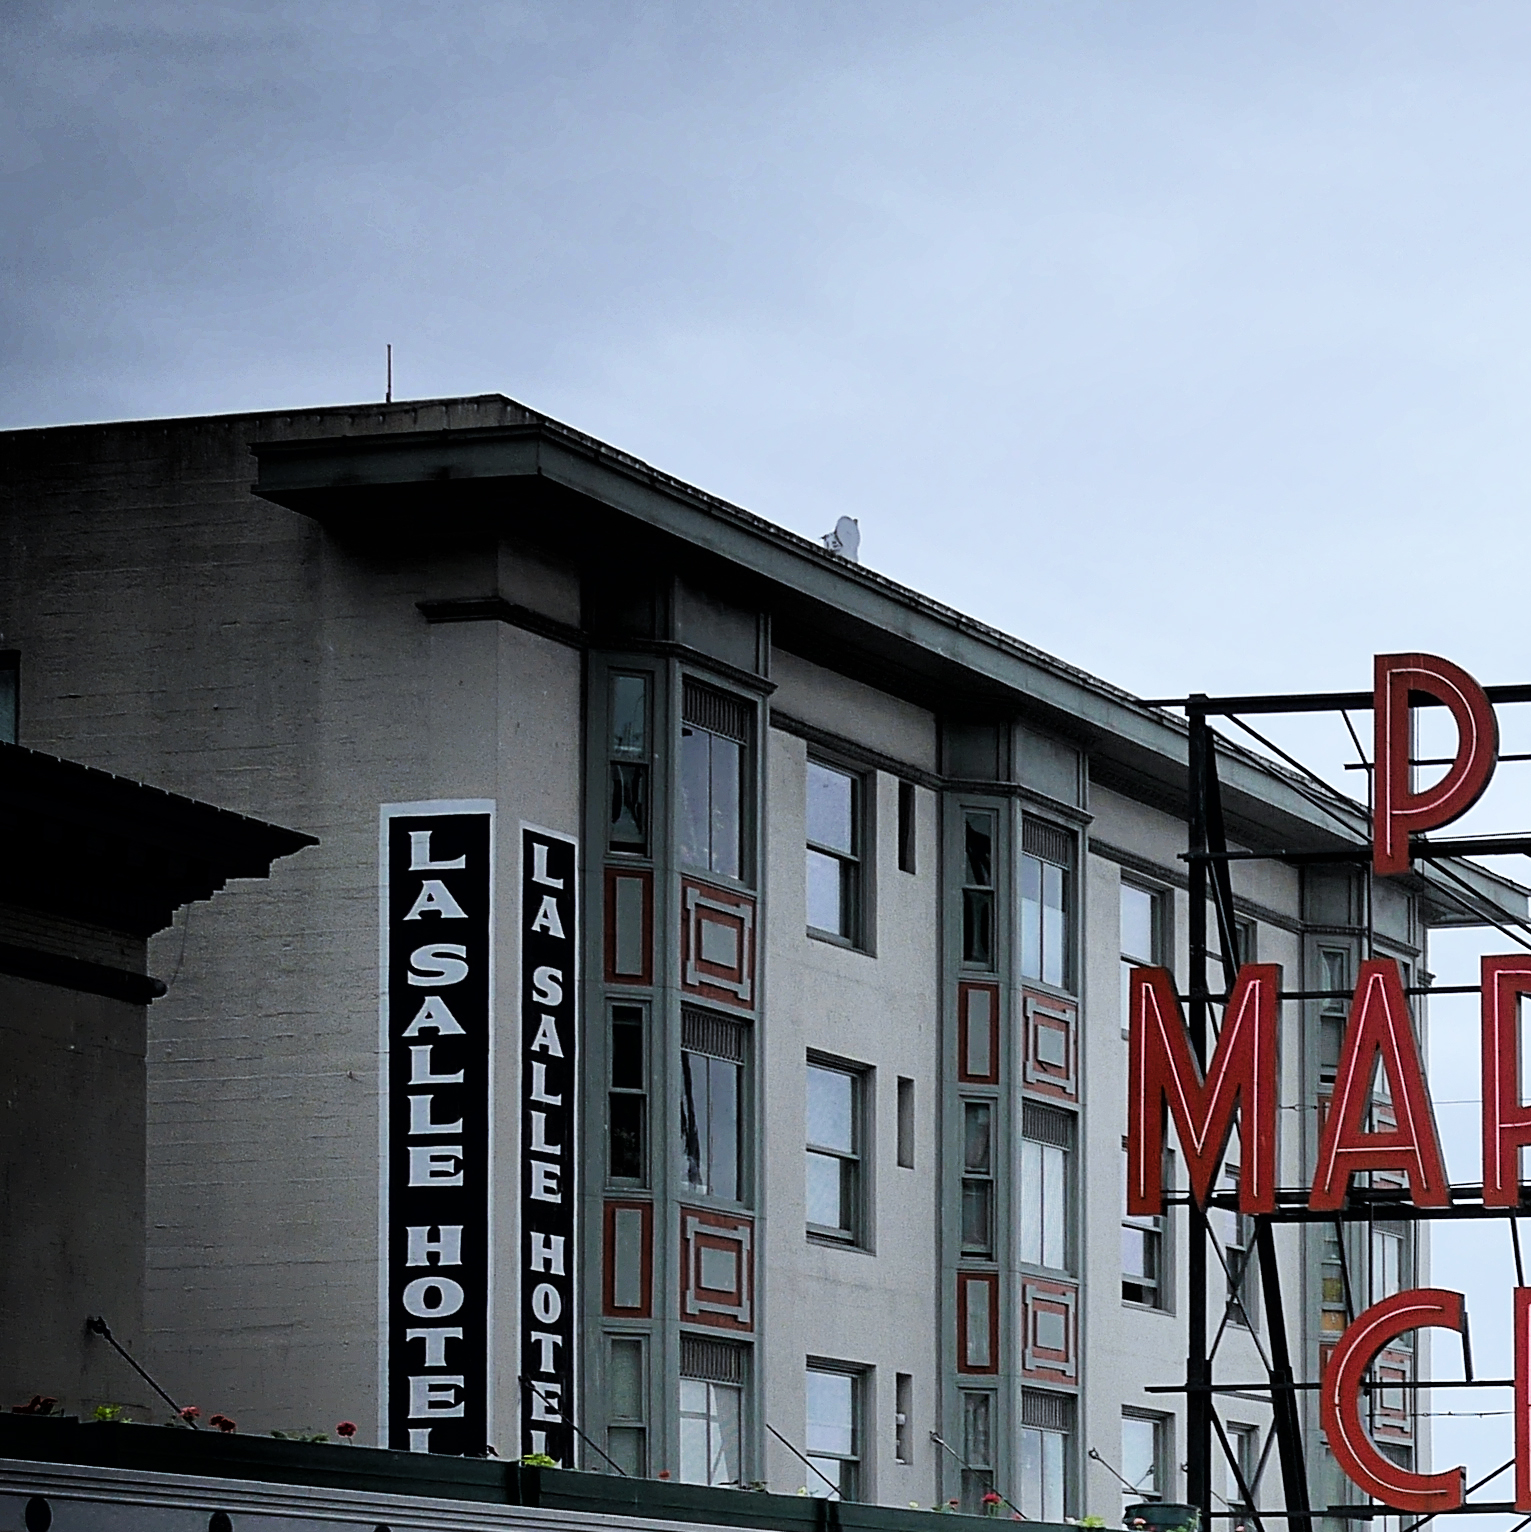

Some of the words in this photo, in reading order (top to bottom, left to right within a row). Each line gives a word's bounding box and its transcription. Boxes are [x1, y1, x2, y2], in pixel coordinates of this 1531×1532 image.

[402, 830, 469, 920] LA
[530, 842, 566, 940] LA
[402, 943, 469, 1187] SALLE
[529, 966, 564, 1205] SALLE
